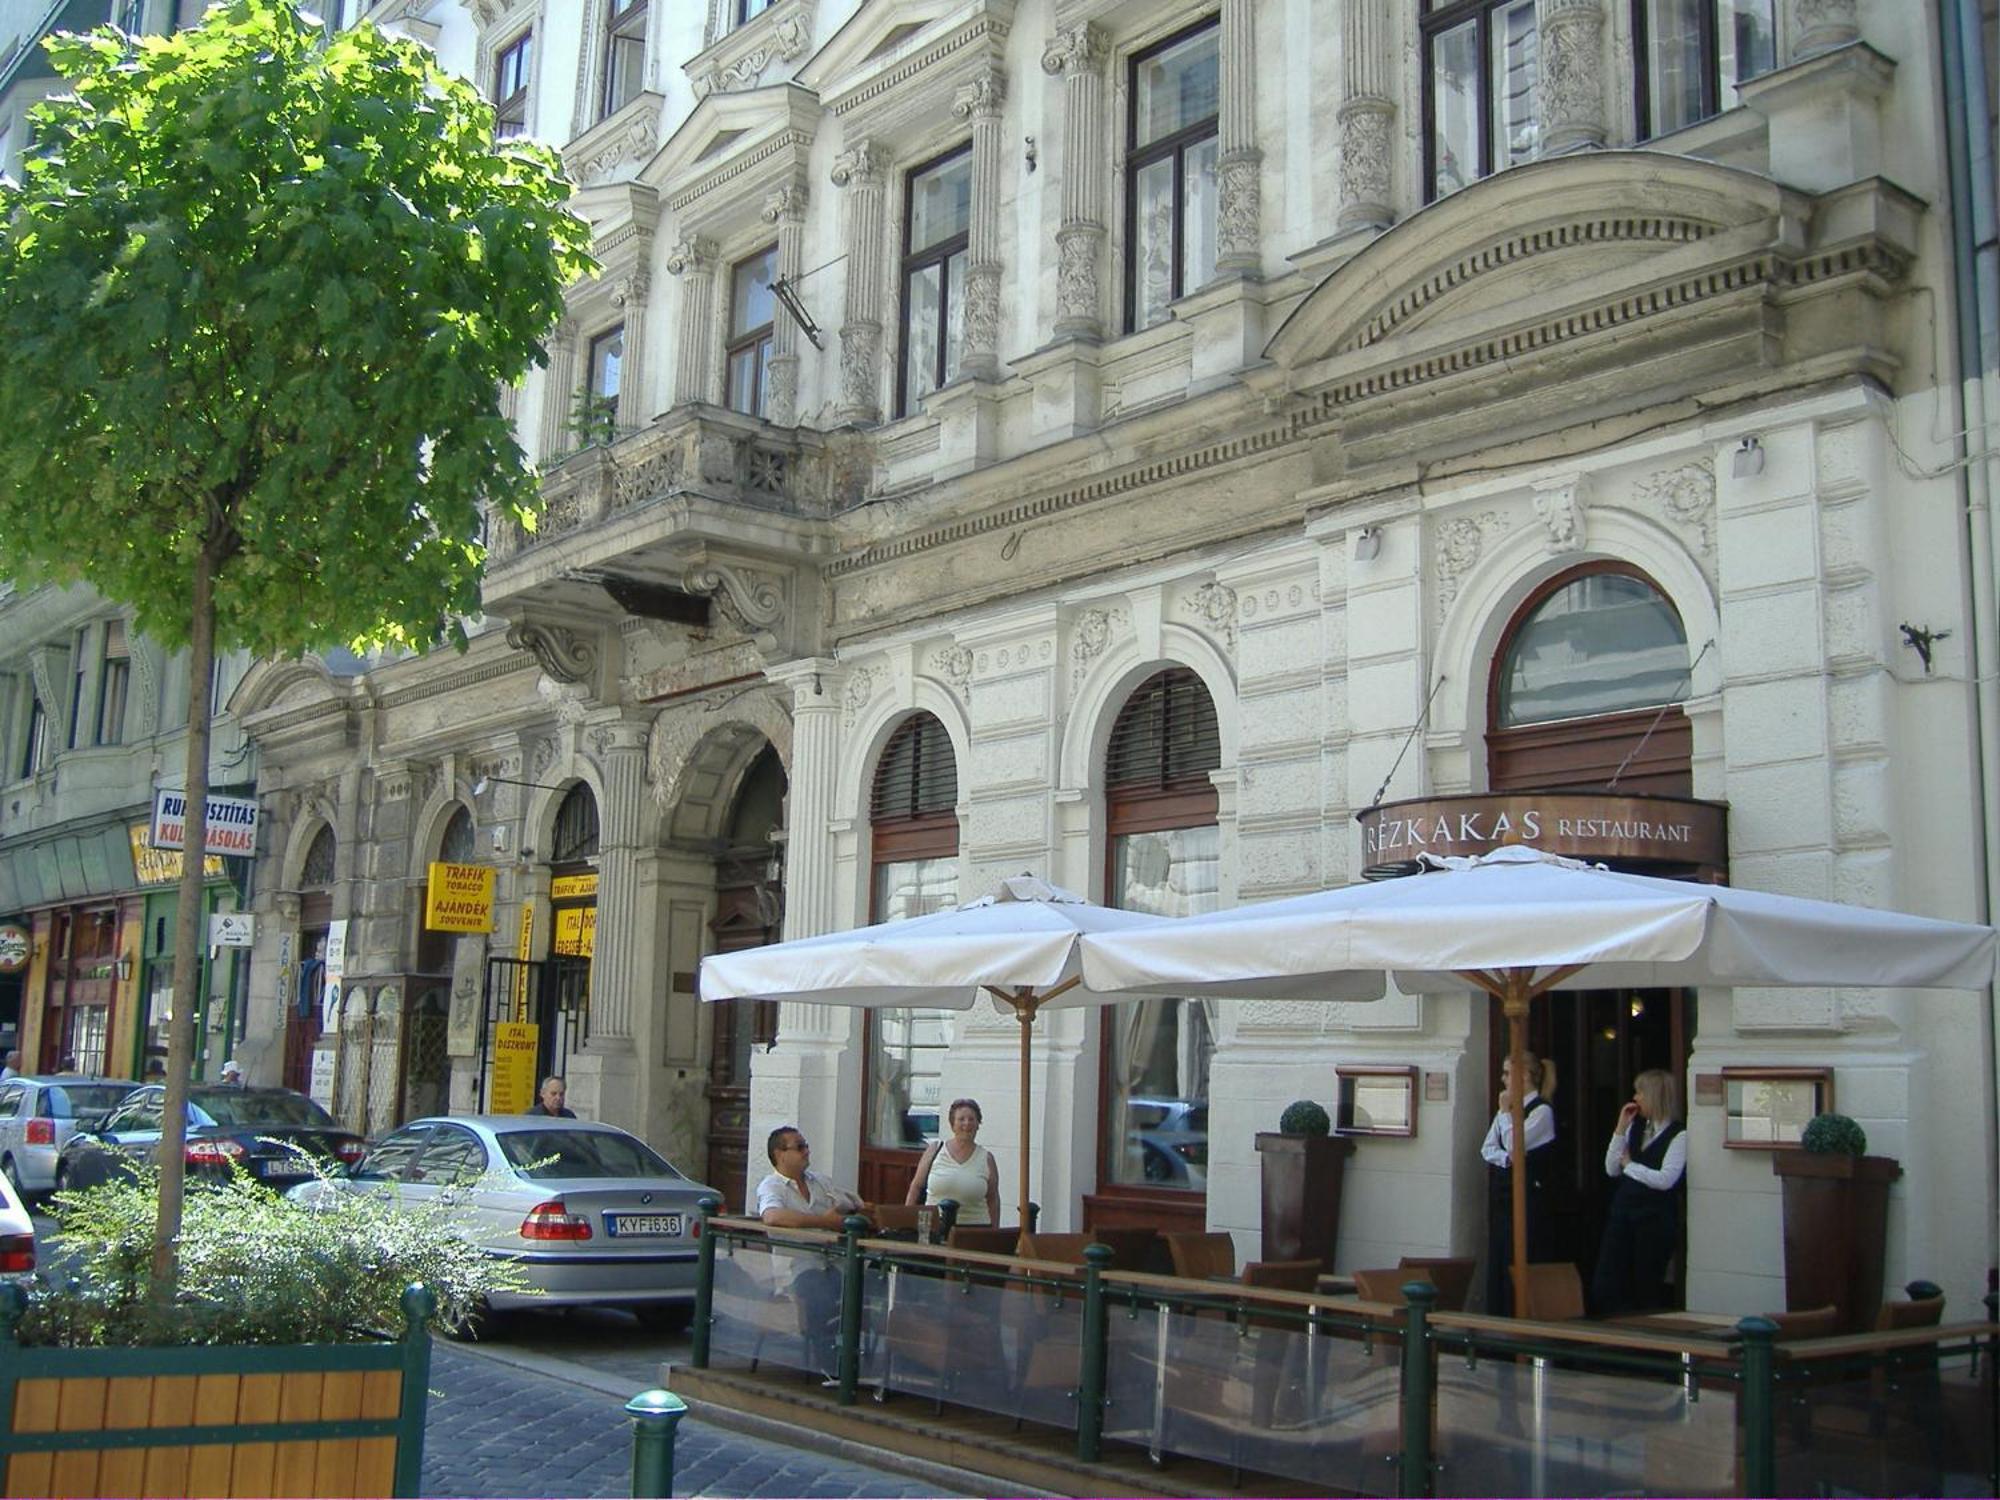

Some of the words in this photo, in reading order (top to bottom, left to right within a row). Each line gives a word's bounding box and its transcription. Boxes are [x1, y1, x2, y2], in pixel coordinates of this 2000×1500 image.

[163, 797, 256, 825] RUSZTÍTÁS
[160, 822, 254, 850] KULÁSOLÁS
[1367, 809, 1540, 853] RÉZKAKAS
[1558, 818, 1692, 842] RESTAURANT
[446, 865, 486, 882] TRAFIK
[447, 881, 484, 892] TOBACCO
[435, 899, 489, 916] AJÁNDÉK
[440, 915, 483, 927] SOUVENIR
